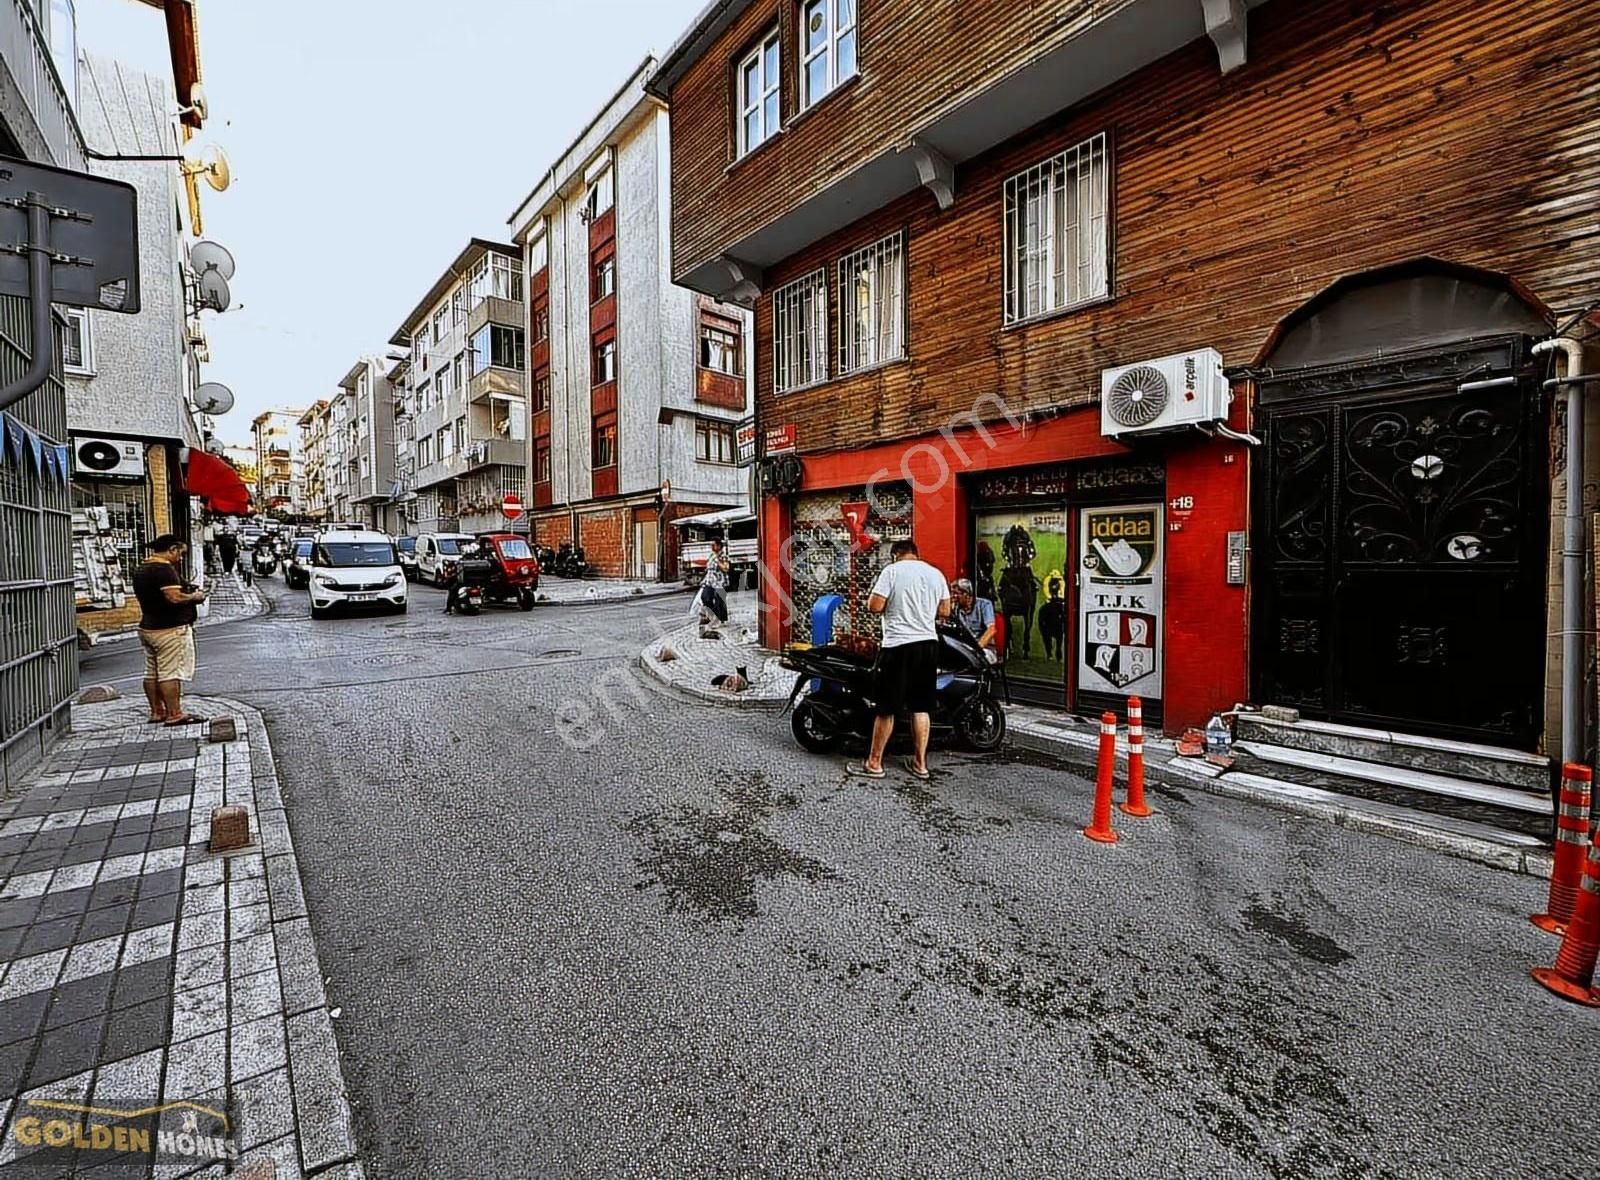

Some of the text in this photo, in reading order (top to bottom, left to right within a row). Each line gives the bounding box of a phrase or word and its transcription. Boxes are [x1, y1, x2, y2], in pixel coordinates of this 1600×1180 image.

[1184, 356, 1196, 391] arçelik
[1169, 495, 1194, 509] +18
[1091, 516, 1151, 537] iddaa
[1094, 594, 1147, 609] T.J.K
